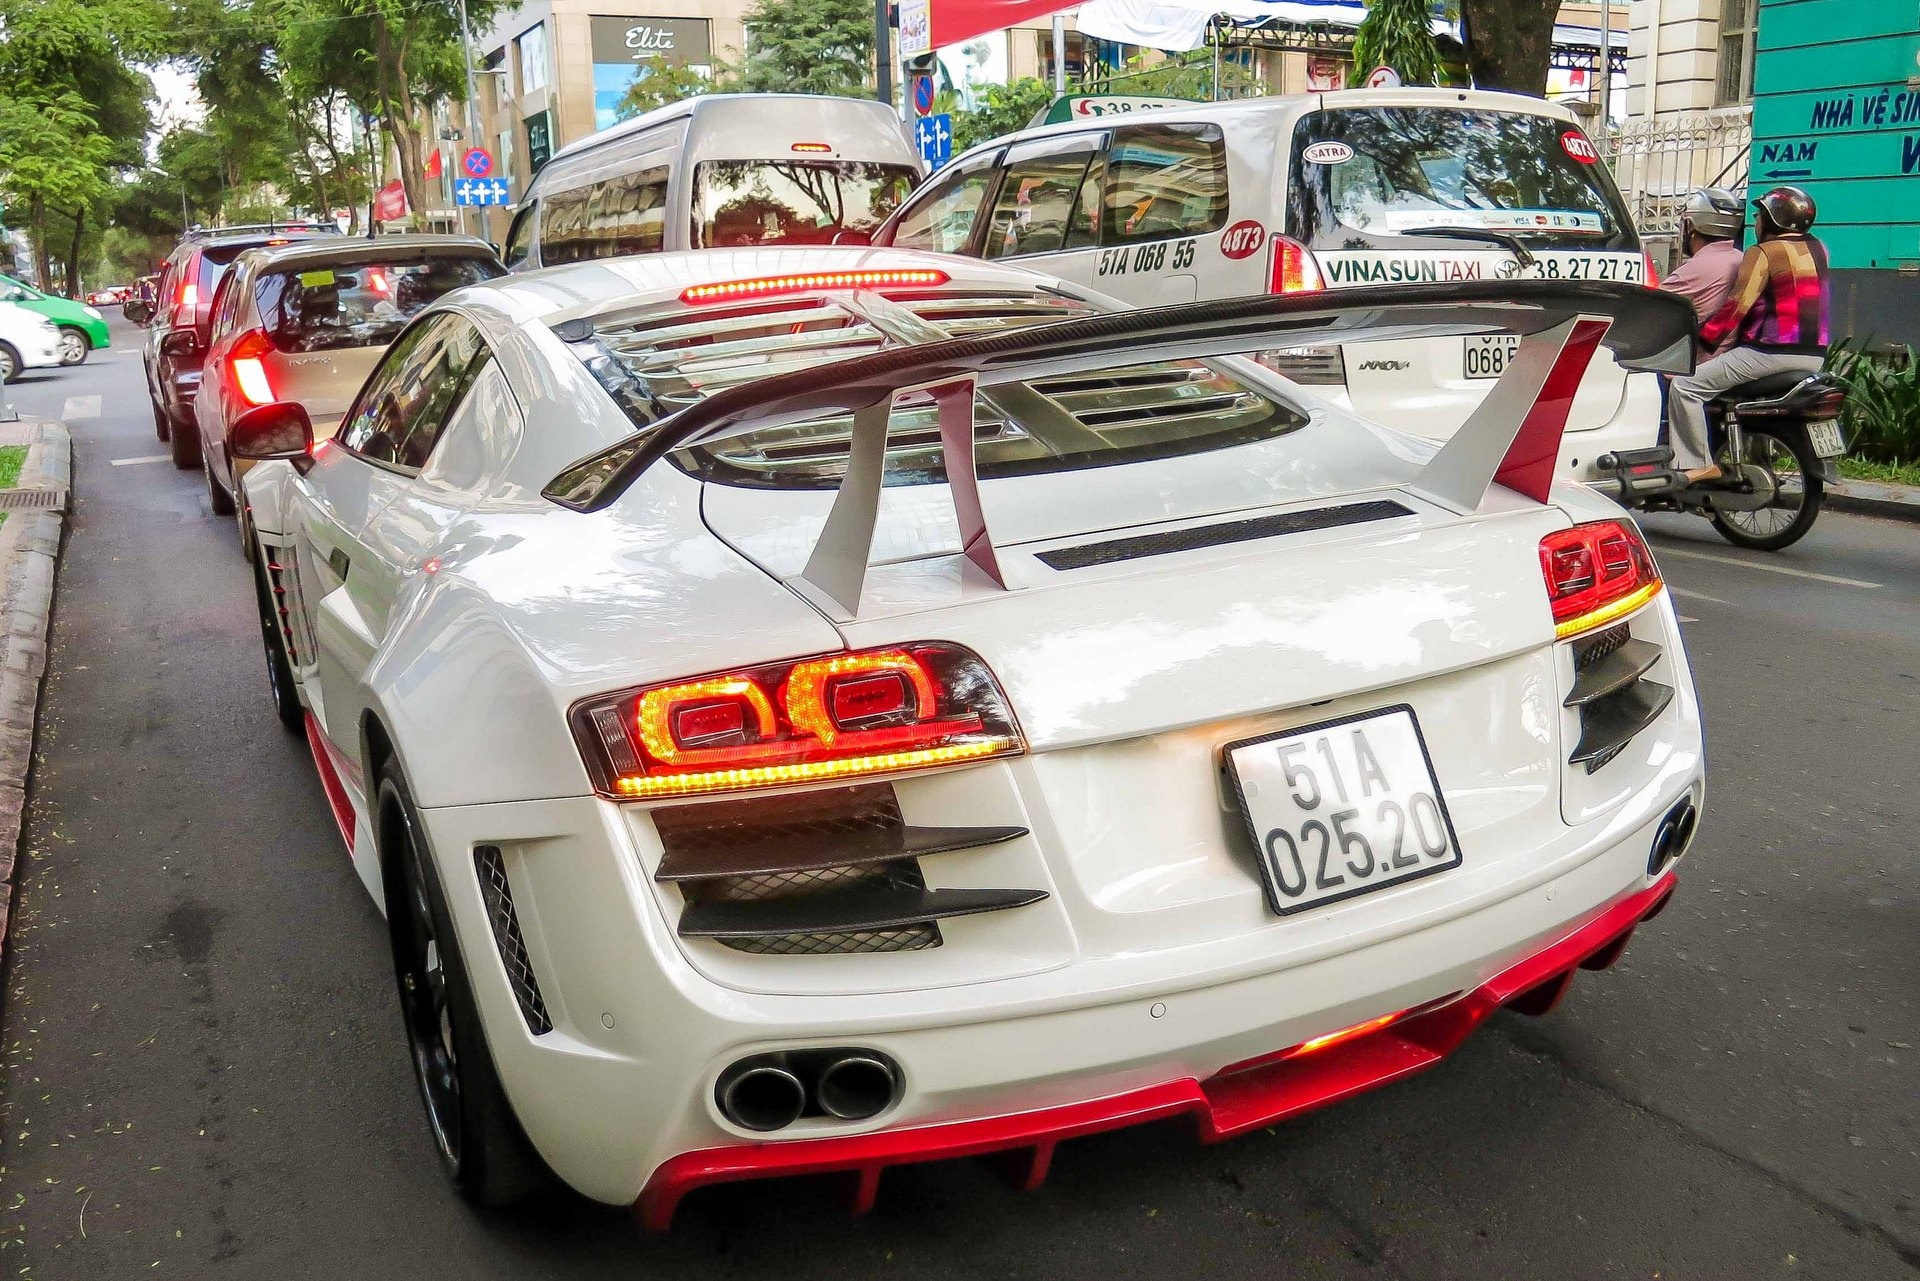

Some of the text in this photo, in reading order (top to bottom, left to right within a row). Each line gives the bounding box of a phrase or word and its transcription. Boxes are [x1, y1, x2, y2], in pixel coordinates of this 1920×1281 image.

[625, 26, 674, 48] Elite
[1810, 93, 1855, 129] NHÀ
[1862, 87, 1890, 130] VỆ
[1310, 147, 1347, 159] SATRA
[1563, 137, 1595, 159] 4873
[1759, 141, 1819, 163] NAM
[1221, 226, 1262, 253] 4873
[1098, 238, 1197, 276] 51A 068 55
[1276, 729, 1391, 811] 51A
[1265, 792, 1448, 897] 025.20
